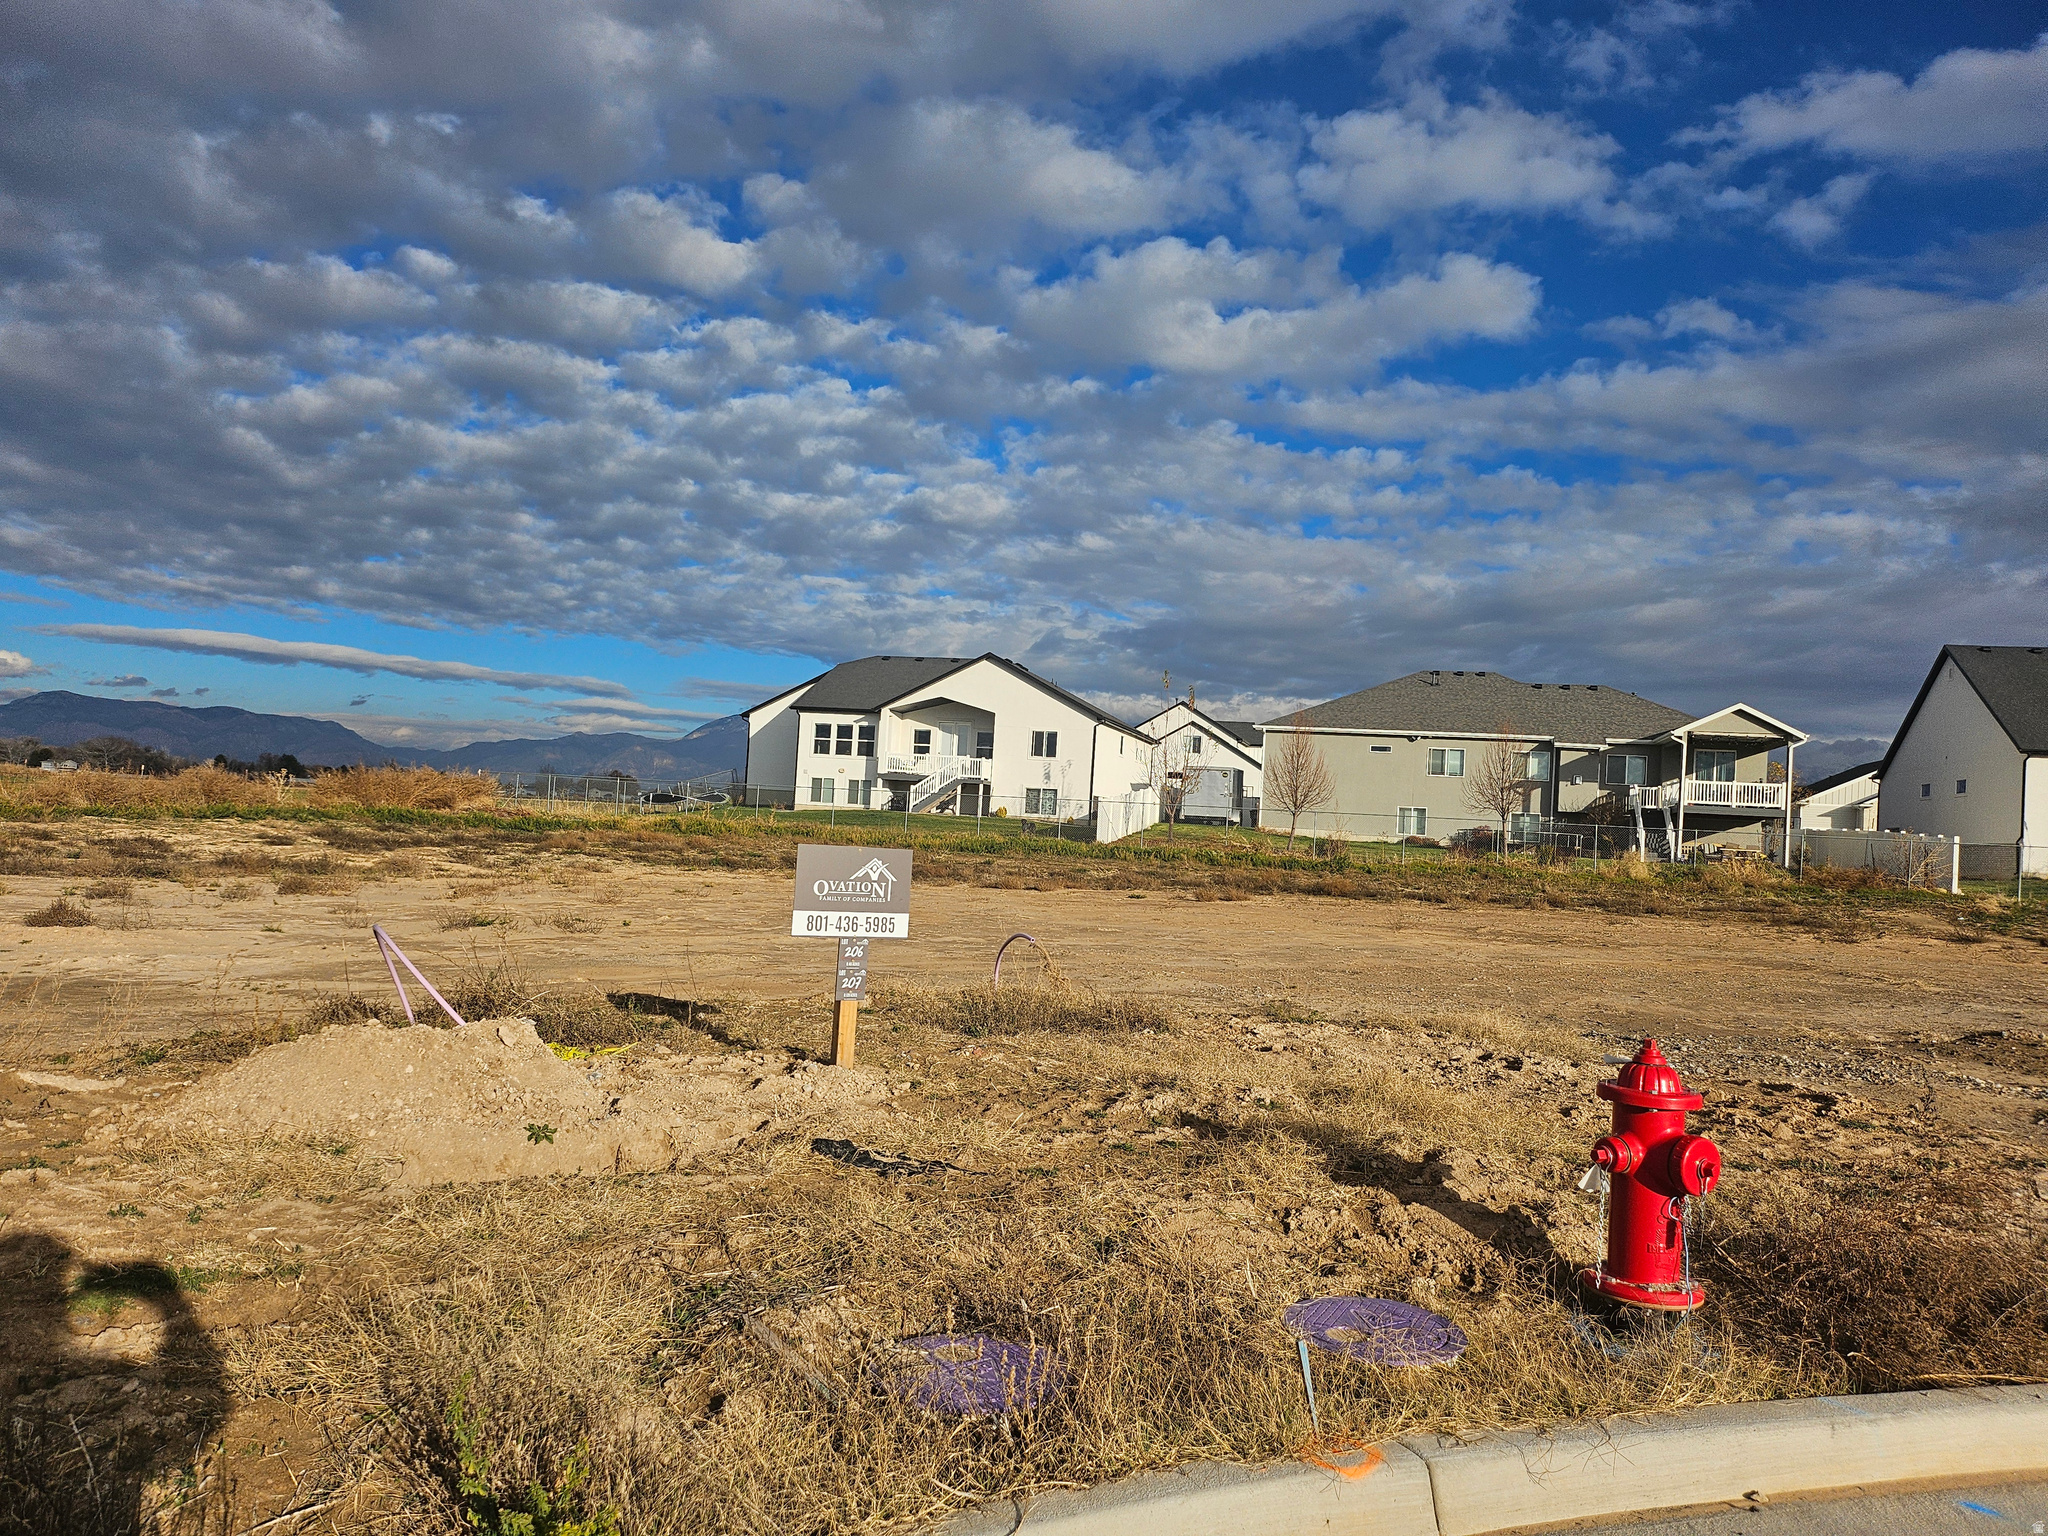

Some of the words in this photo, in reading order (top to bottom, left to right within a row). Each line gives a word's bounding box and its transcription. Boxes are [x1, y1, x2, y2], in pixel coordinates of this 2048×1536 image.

[813, 879, 887, 898] OVATION
[806, 915, 896, 933] 801-436-5985
[844, 945, 864, 957] 206
[841, 976, 862, 989] 207
